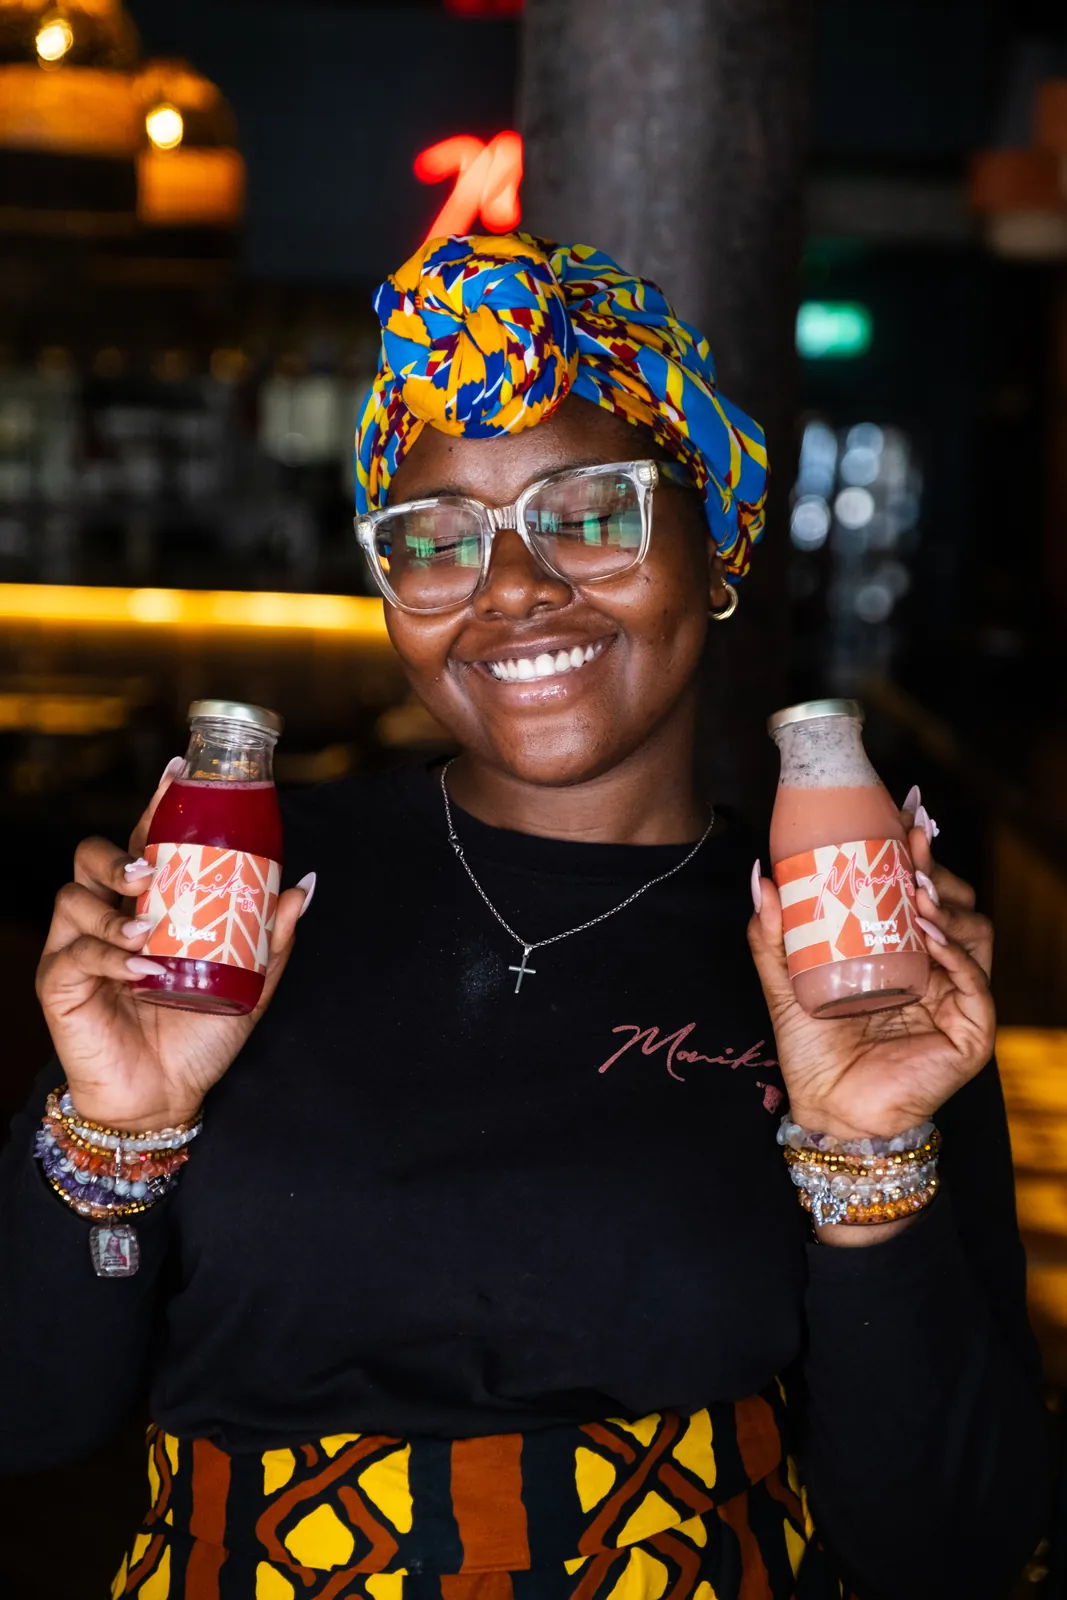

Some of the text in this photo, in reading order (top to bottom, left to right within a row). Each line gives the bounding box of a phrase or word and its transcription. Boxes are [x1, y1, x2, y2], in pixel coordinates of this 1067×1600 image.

[141, 854, 260, 915] Monika
[808, 851, 913, 921] Monika
[860, 919, 899, 933] Berry
[863, 932, 902, 947] Boost
[597, 1021, 779, 1082] Monika
